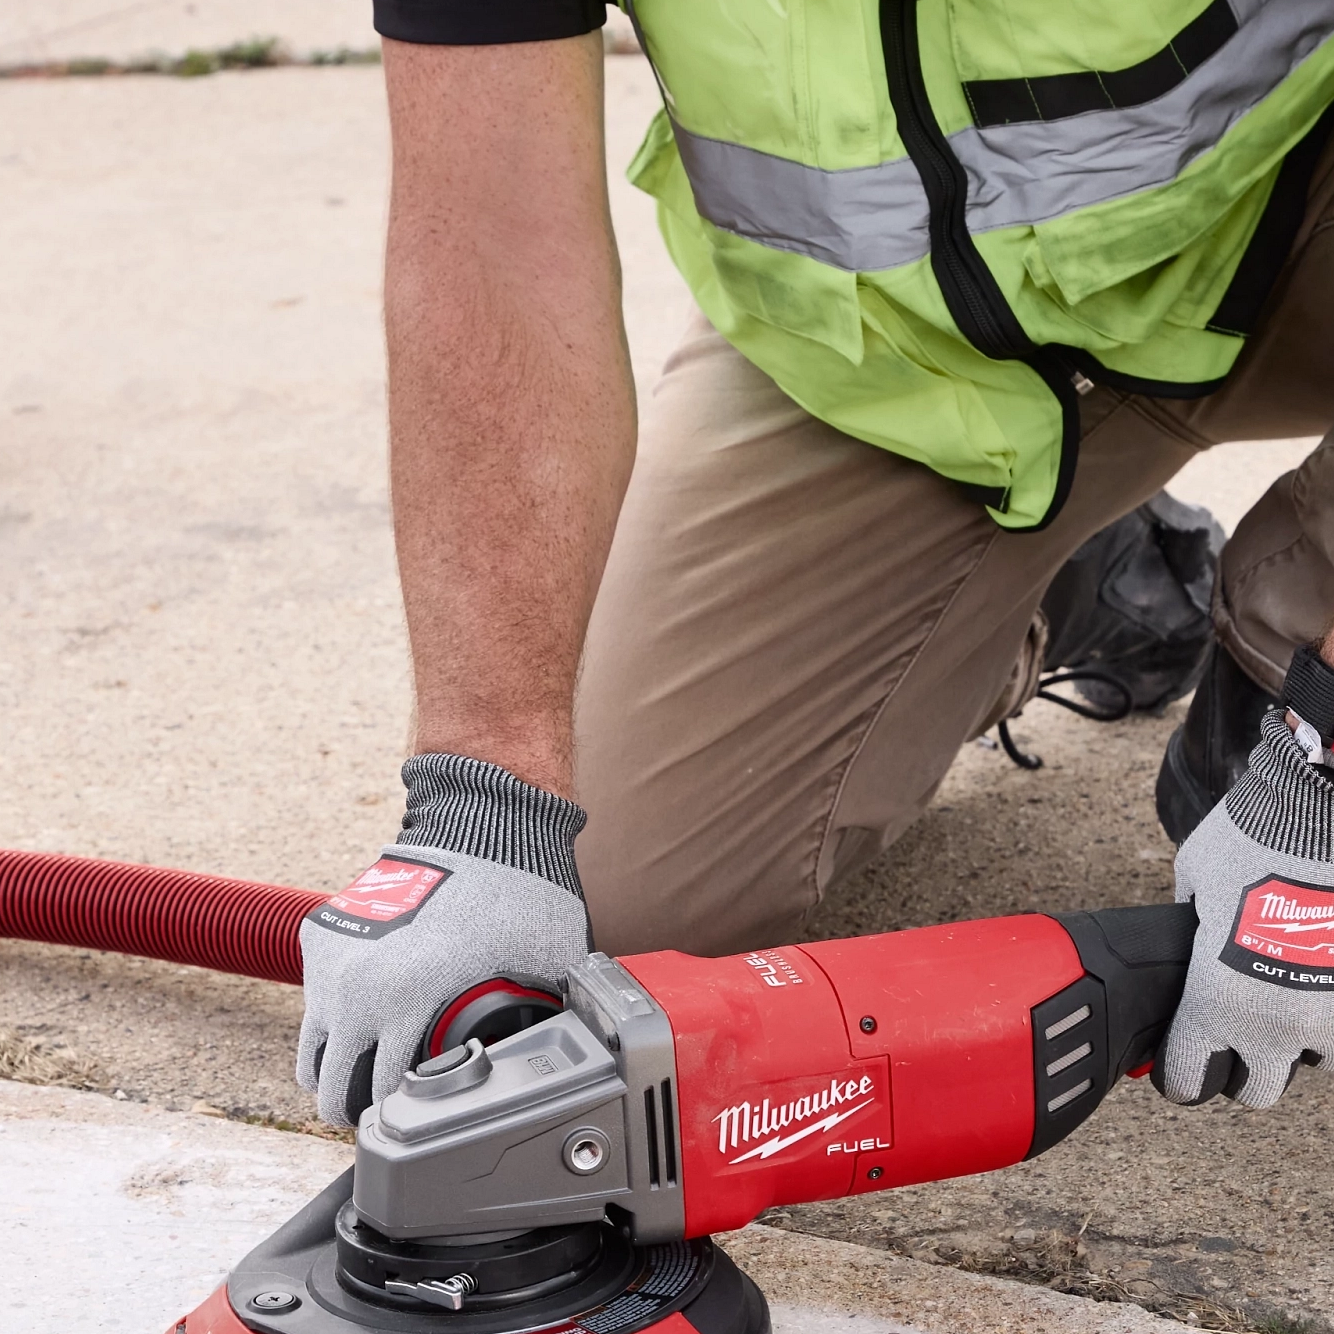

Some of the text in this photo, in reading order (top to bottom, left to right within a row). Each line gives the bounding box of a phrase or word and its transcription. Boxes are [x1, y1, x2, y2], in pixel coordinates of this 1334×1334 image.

[320, 911, 371, 933] CUT LEVEL 3
[1267, 944, 1283, 957] M
[743, 953, 787, 987] FUEL
[1252, 962, 1286, 978] CUT
[711, 1075, 874, 1154] Milwaukee
[826, 1137, 890, 1156] FUEL
